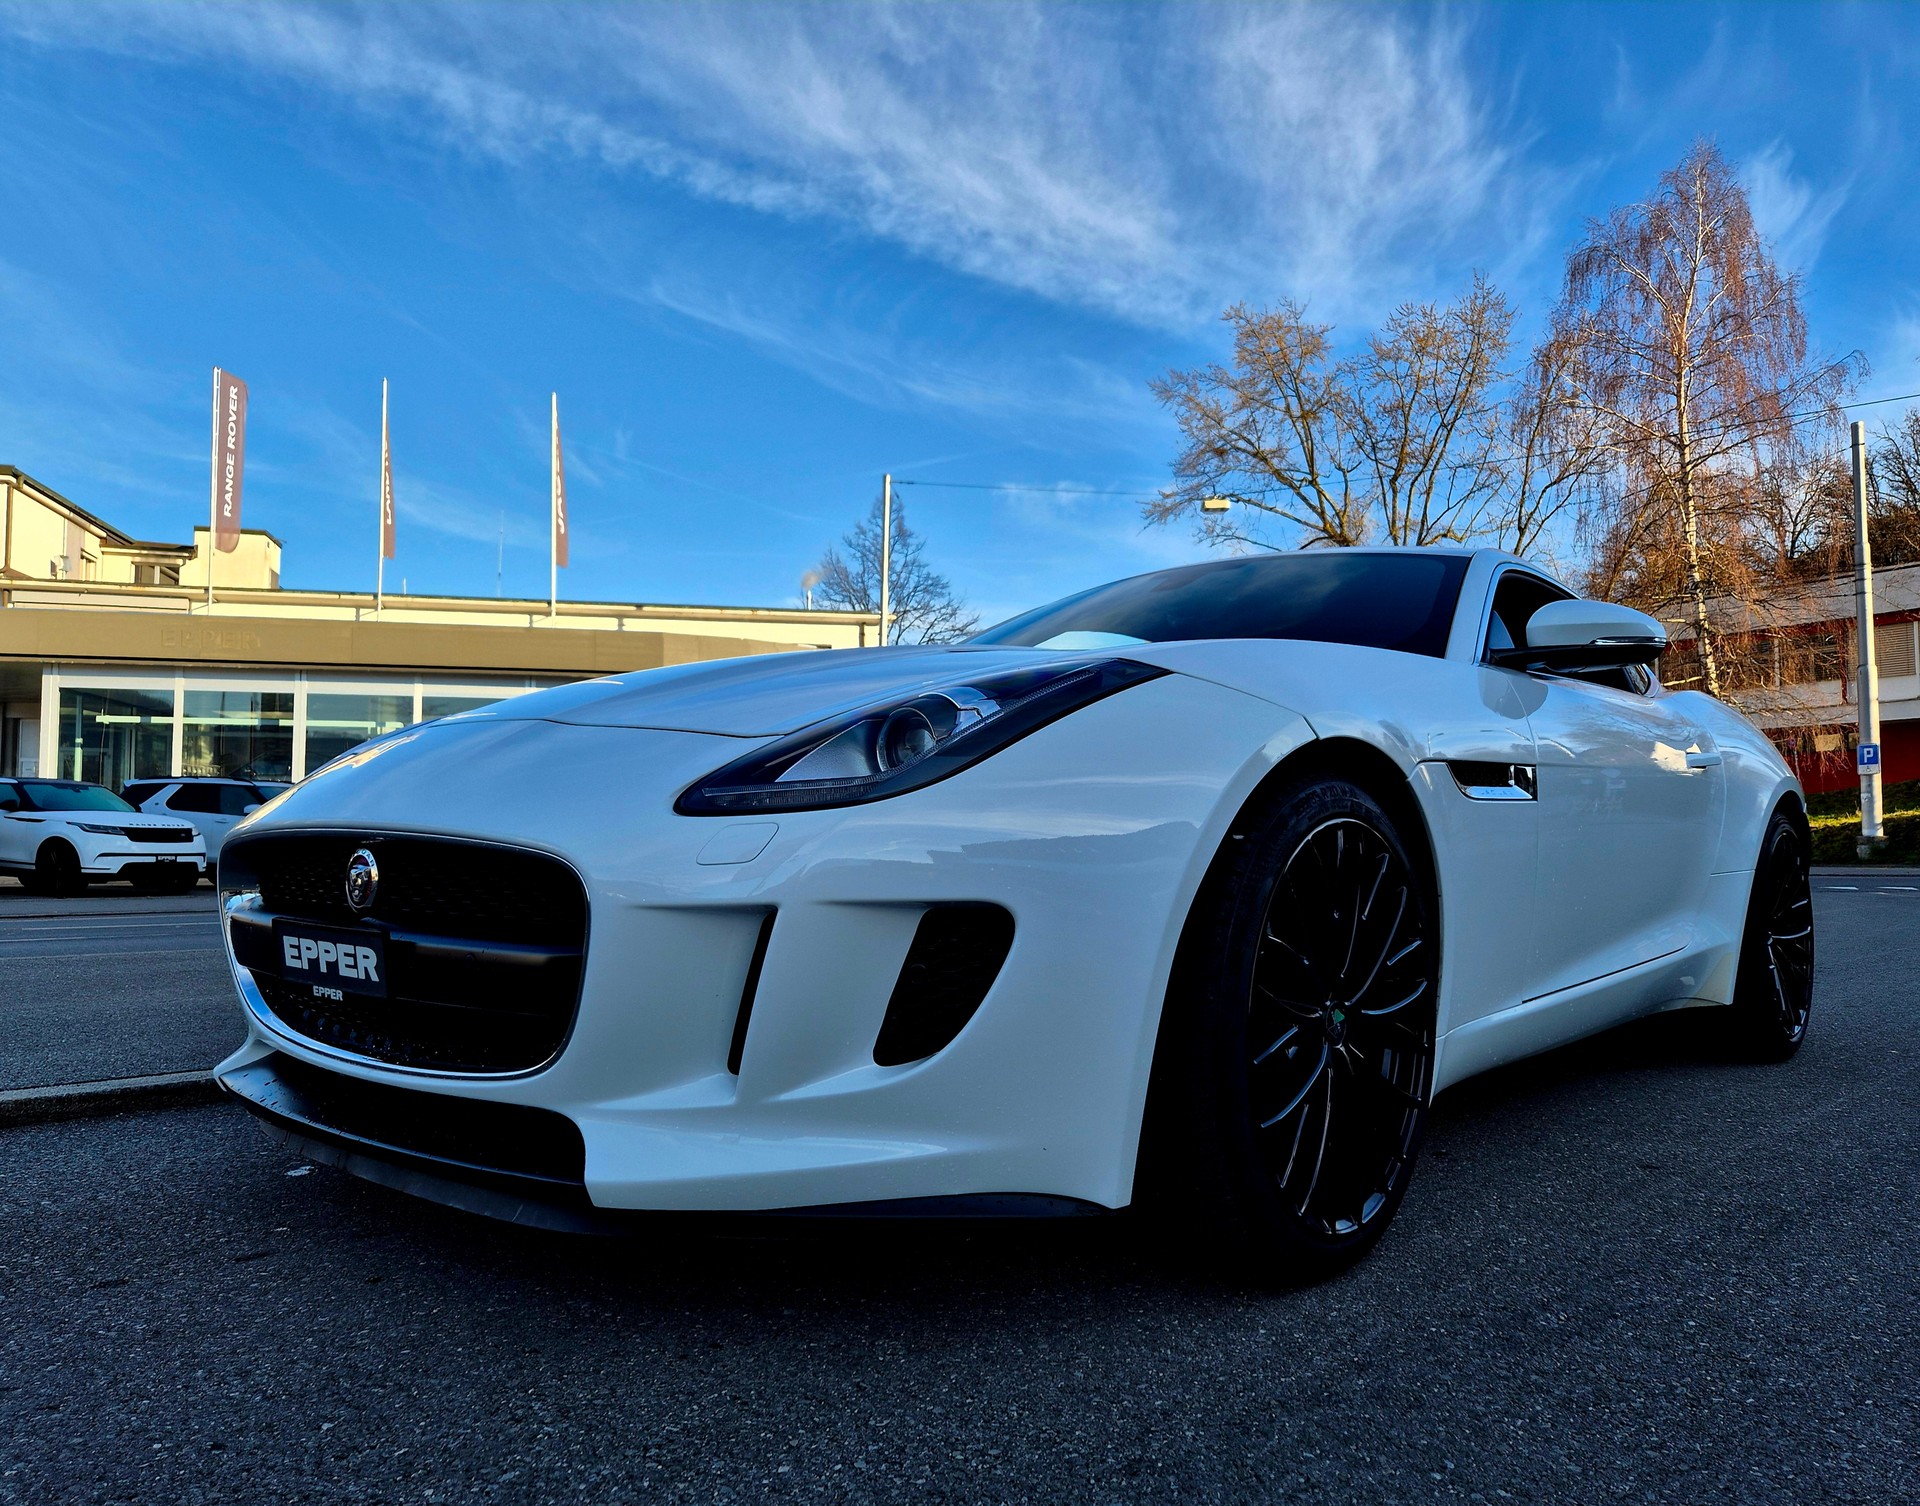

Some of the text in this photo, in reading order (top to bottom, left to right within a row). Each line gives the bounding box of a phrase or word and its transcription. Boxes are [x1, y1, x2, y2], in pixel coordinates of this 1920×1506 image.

[223, 385, 239, 518] RANGE ROVER
[160, 629, 261, 650] EPPER
[1863, 747, 1874, 764] P
[282, 935, 380, 982] EPPER
[312, 985, 343, 1001] EPPER
